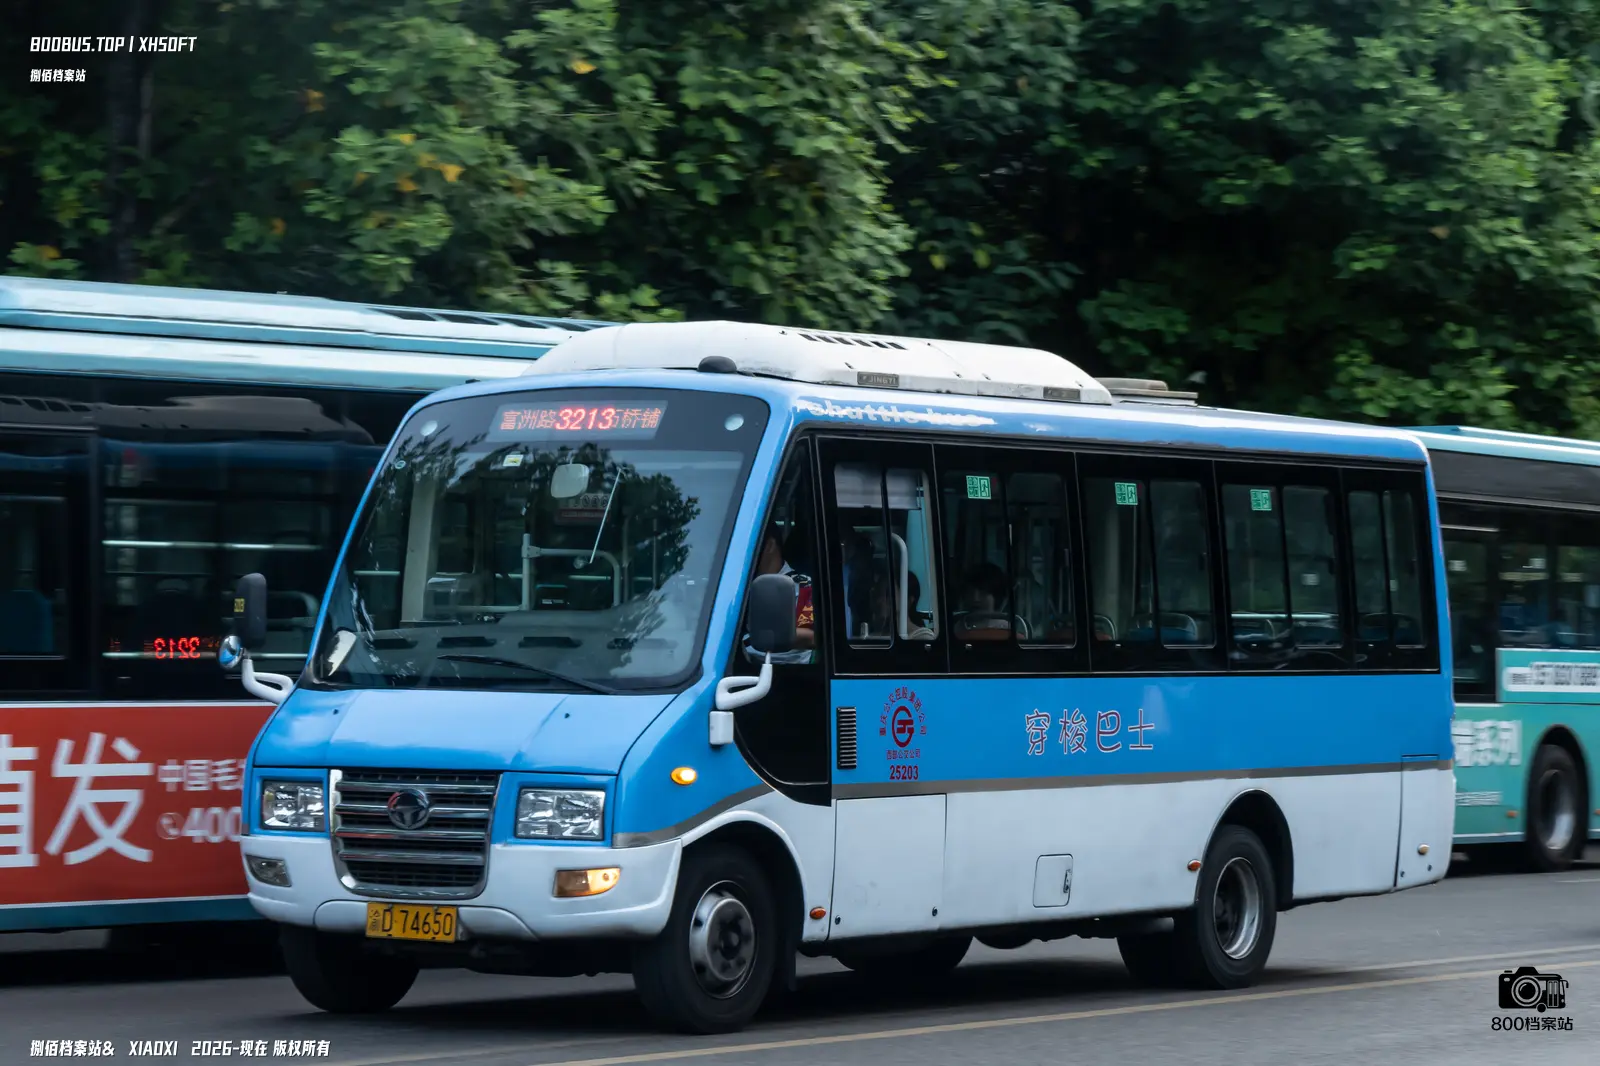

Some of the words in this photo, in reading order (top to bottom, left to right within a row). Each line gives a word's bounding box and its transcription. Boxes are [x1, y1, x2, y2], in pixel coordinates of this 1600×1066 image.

[501, 410, 557, 430] 富洲路
[555, 407, 616, 430] 3213
[1024, 708, 1155, 756] 穿梭巴士
[157, 758, 244, 792] 中国毛
[889, 764, 919, 780] 25203
